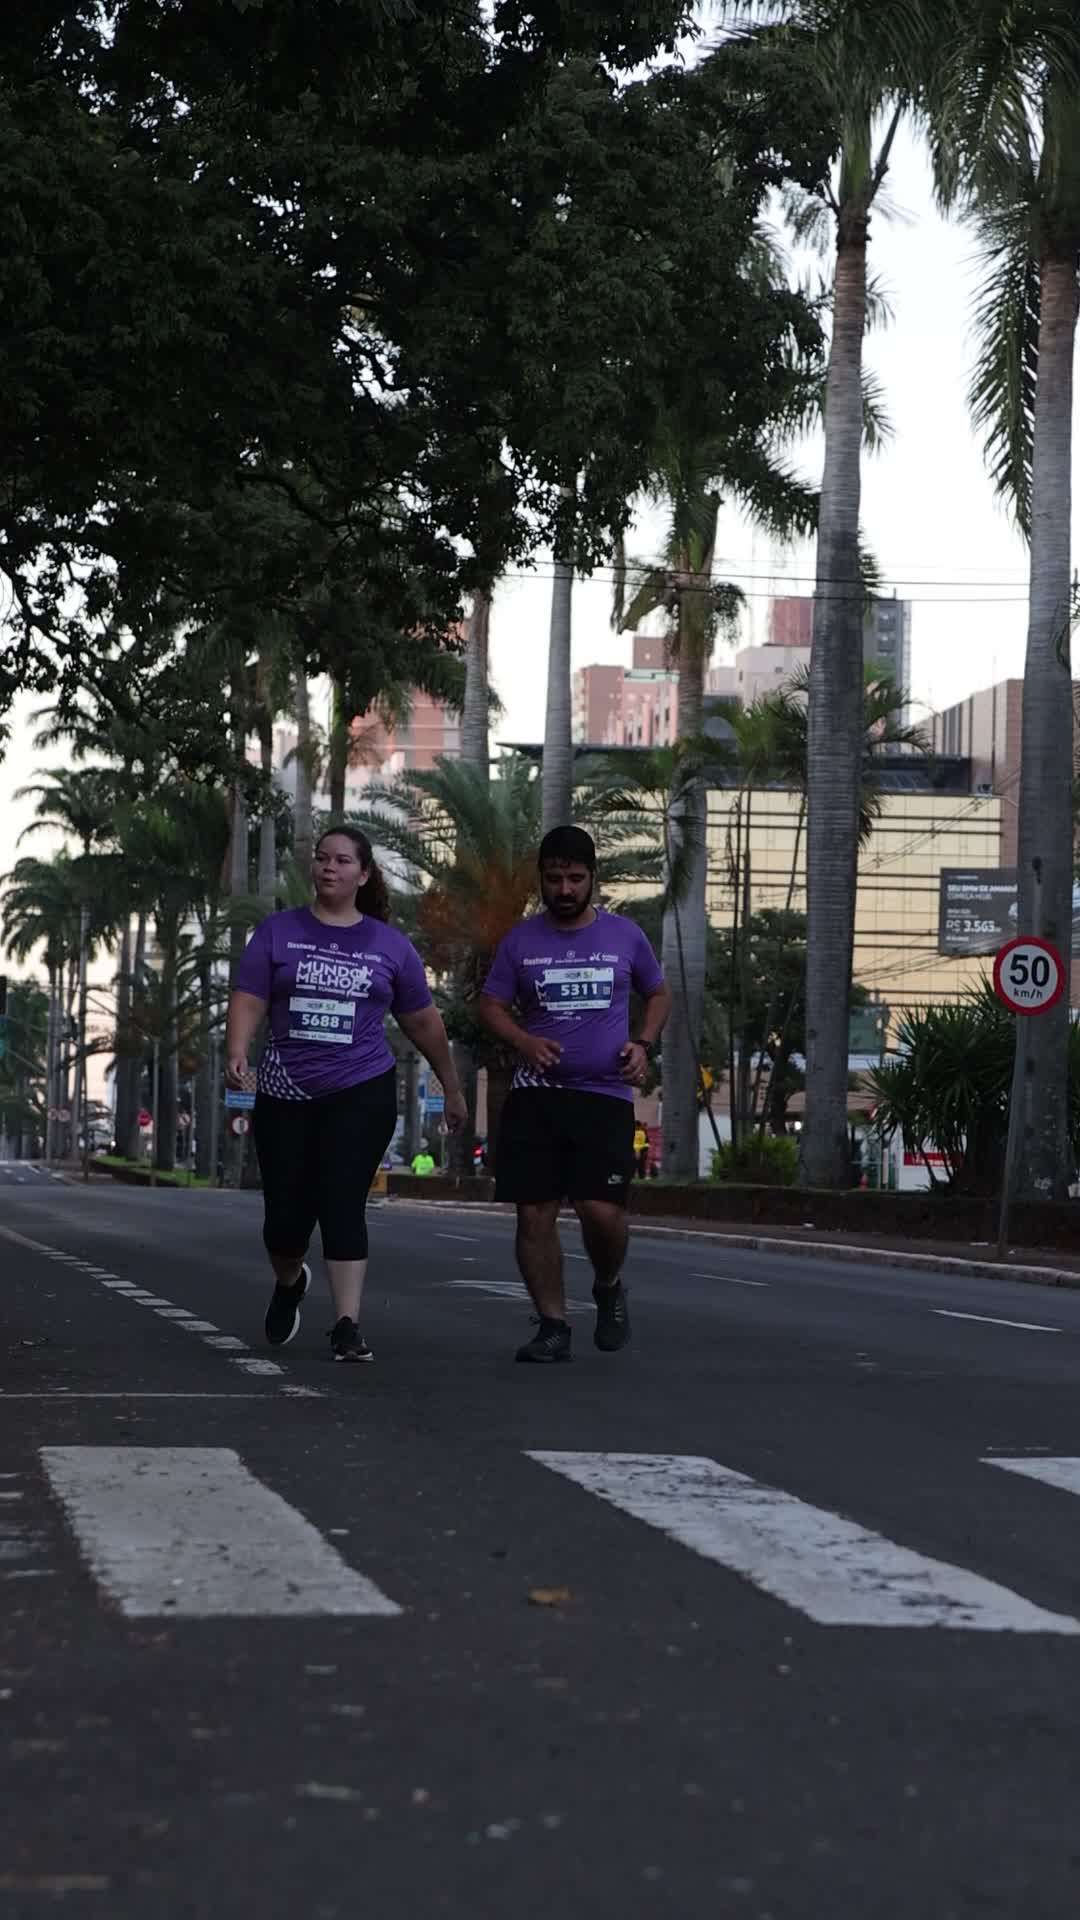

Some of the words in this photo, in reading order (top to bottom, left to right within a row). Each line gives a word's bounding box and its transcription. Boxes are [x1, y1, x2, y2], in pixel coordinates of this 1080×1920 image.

[297, 960, 362, 978] MUNDO
[1009, 954, 1050, 987] 50
[560, 983, 598, 996] 5311
[1013, 988, 1043, 999] km/h
[301, 1013, 340, 1028] 5688
